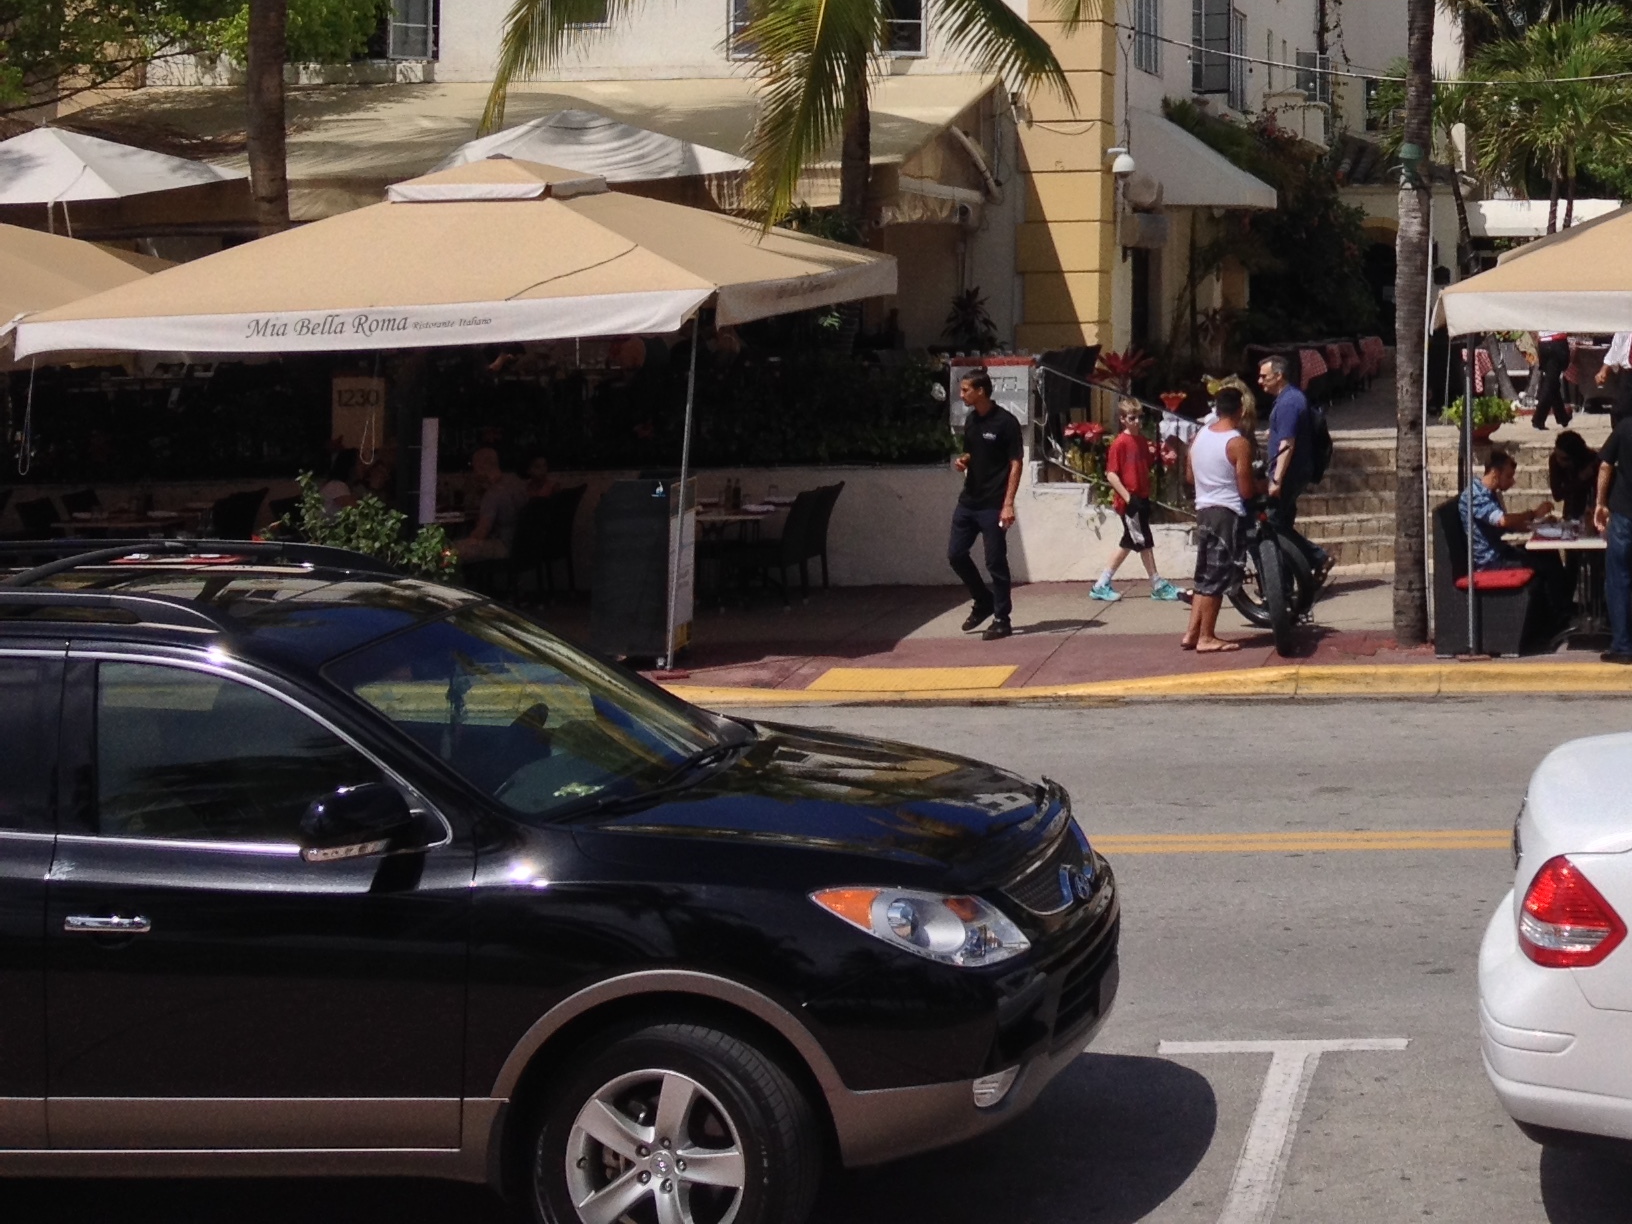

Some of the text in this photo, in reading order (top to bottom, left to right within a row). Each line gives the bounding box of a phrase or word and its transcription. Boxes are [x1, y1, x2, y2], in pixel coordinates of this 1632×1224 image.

[245, 314, 493, 338] Mia Bella Roma Ristorante Italiano
[337, 388, 380, 407] 1230
